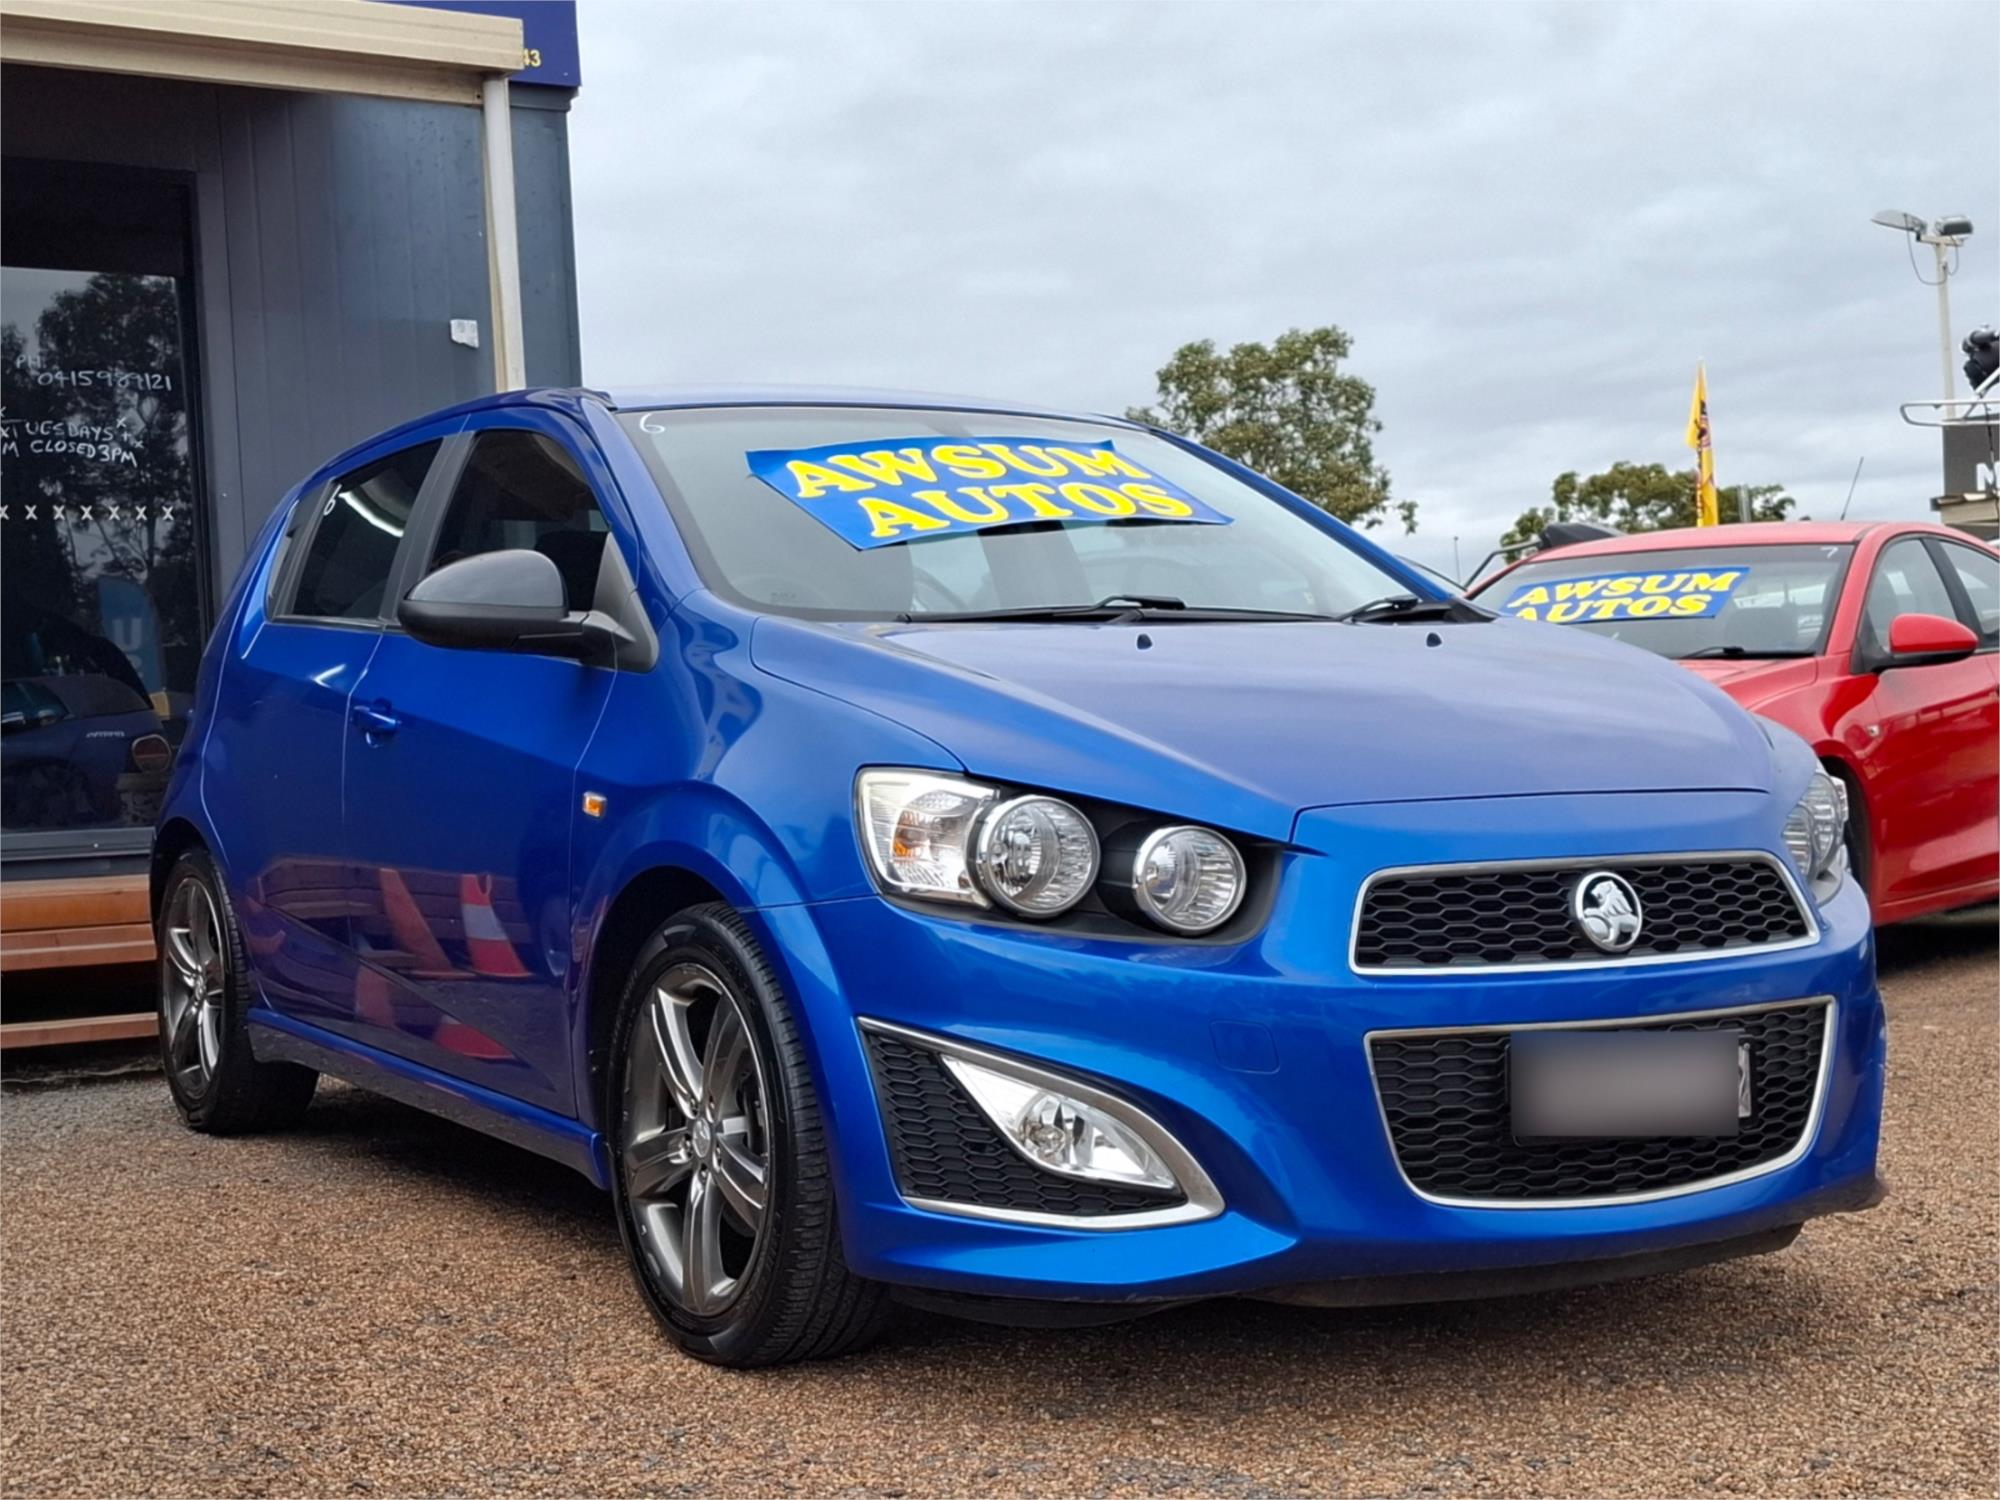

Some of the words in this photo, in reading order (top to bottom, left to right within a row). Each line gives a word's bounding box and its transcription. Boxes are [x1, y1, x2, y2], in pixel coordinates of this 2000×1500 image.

[639, 412, 665, 434] 6
[30, 440, 96, 459] CLOSED
[98, 444, 138, 468] 3PM
[786, 447, 1152, 498] AWSUM
[858, 482, 1193, 537] AUTOS
[1507, 571, 1742, 608] AWSUM
